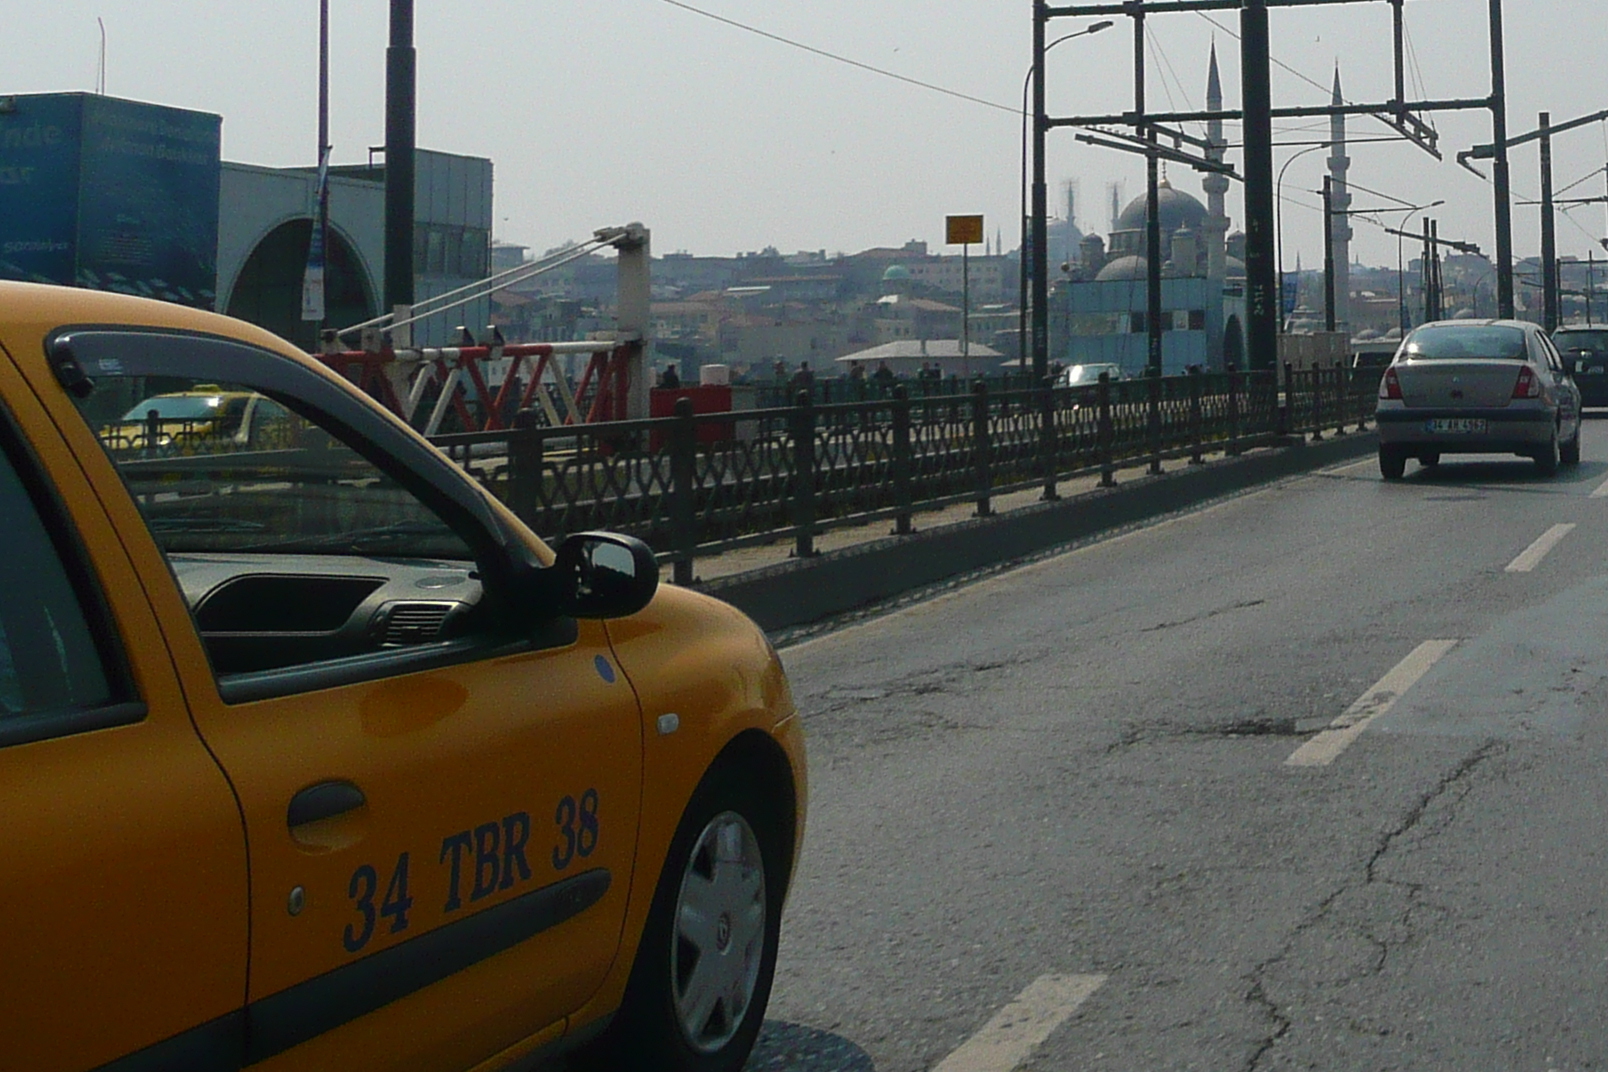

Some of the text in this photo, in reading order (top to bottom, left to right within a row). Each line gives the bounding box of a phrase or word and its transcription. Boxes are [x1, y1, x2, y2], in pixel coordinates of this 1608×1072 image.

[342, 787, 600, 953] 34 TBR 38
